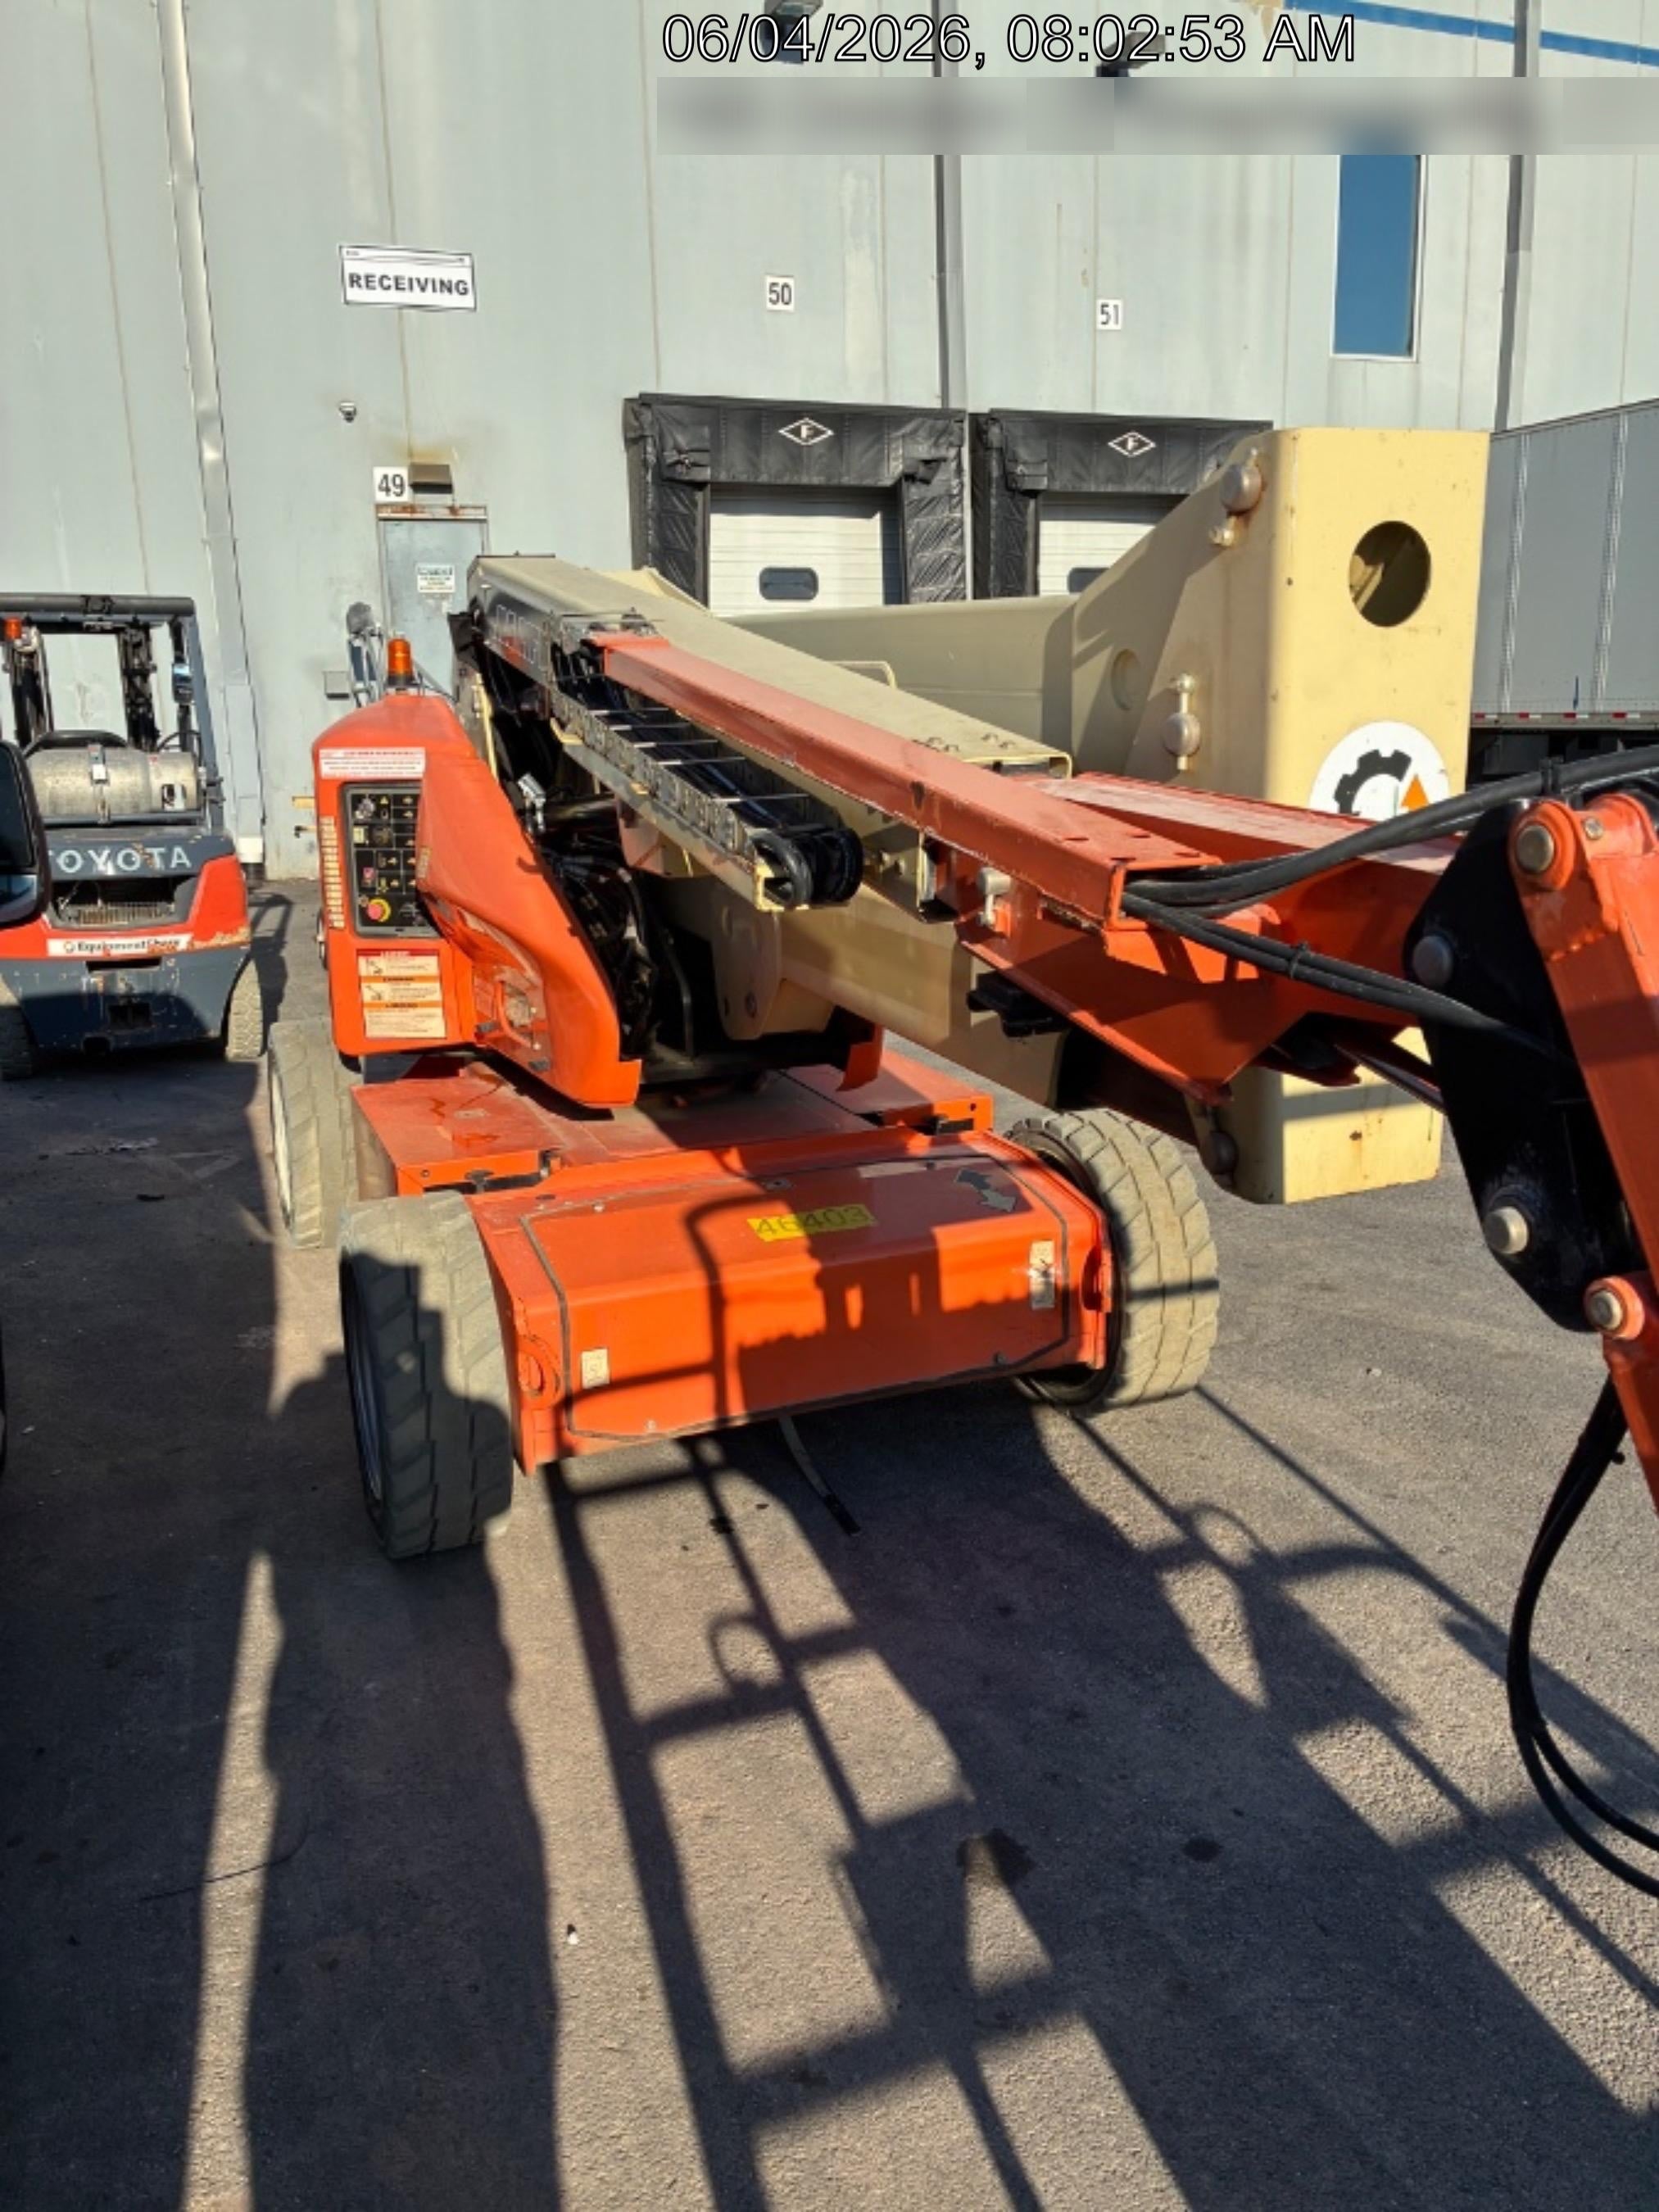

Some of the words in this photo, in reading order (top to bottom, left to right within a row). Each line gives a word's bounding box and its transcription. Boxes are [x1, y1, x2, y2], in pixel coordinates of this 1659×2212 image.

[347, 272, 469, 297] RECEIVING
[768, 281, 792, 306] 50
[1099, 301, 1119, 325] 51
[378, 474, 406, 497] 49
[48, 845, 192, 874] OYOTA
[756, 1205, 870, 1235] 46403
